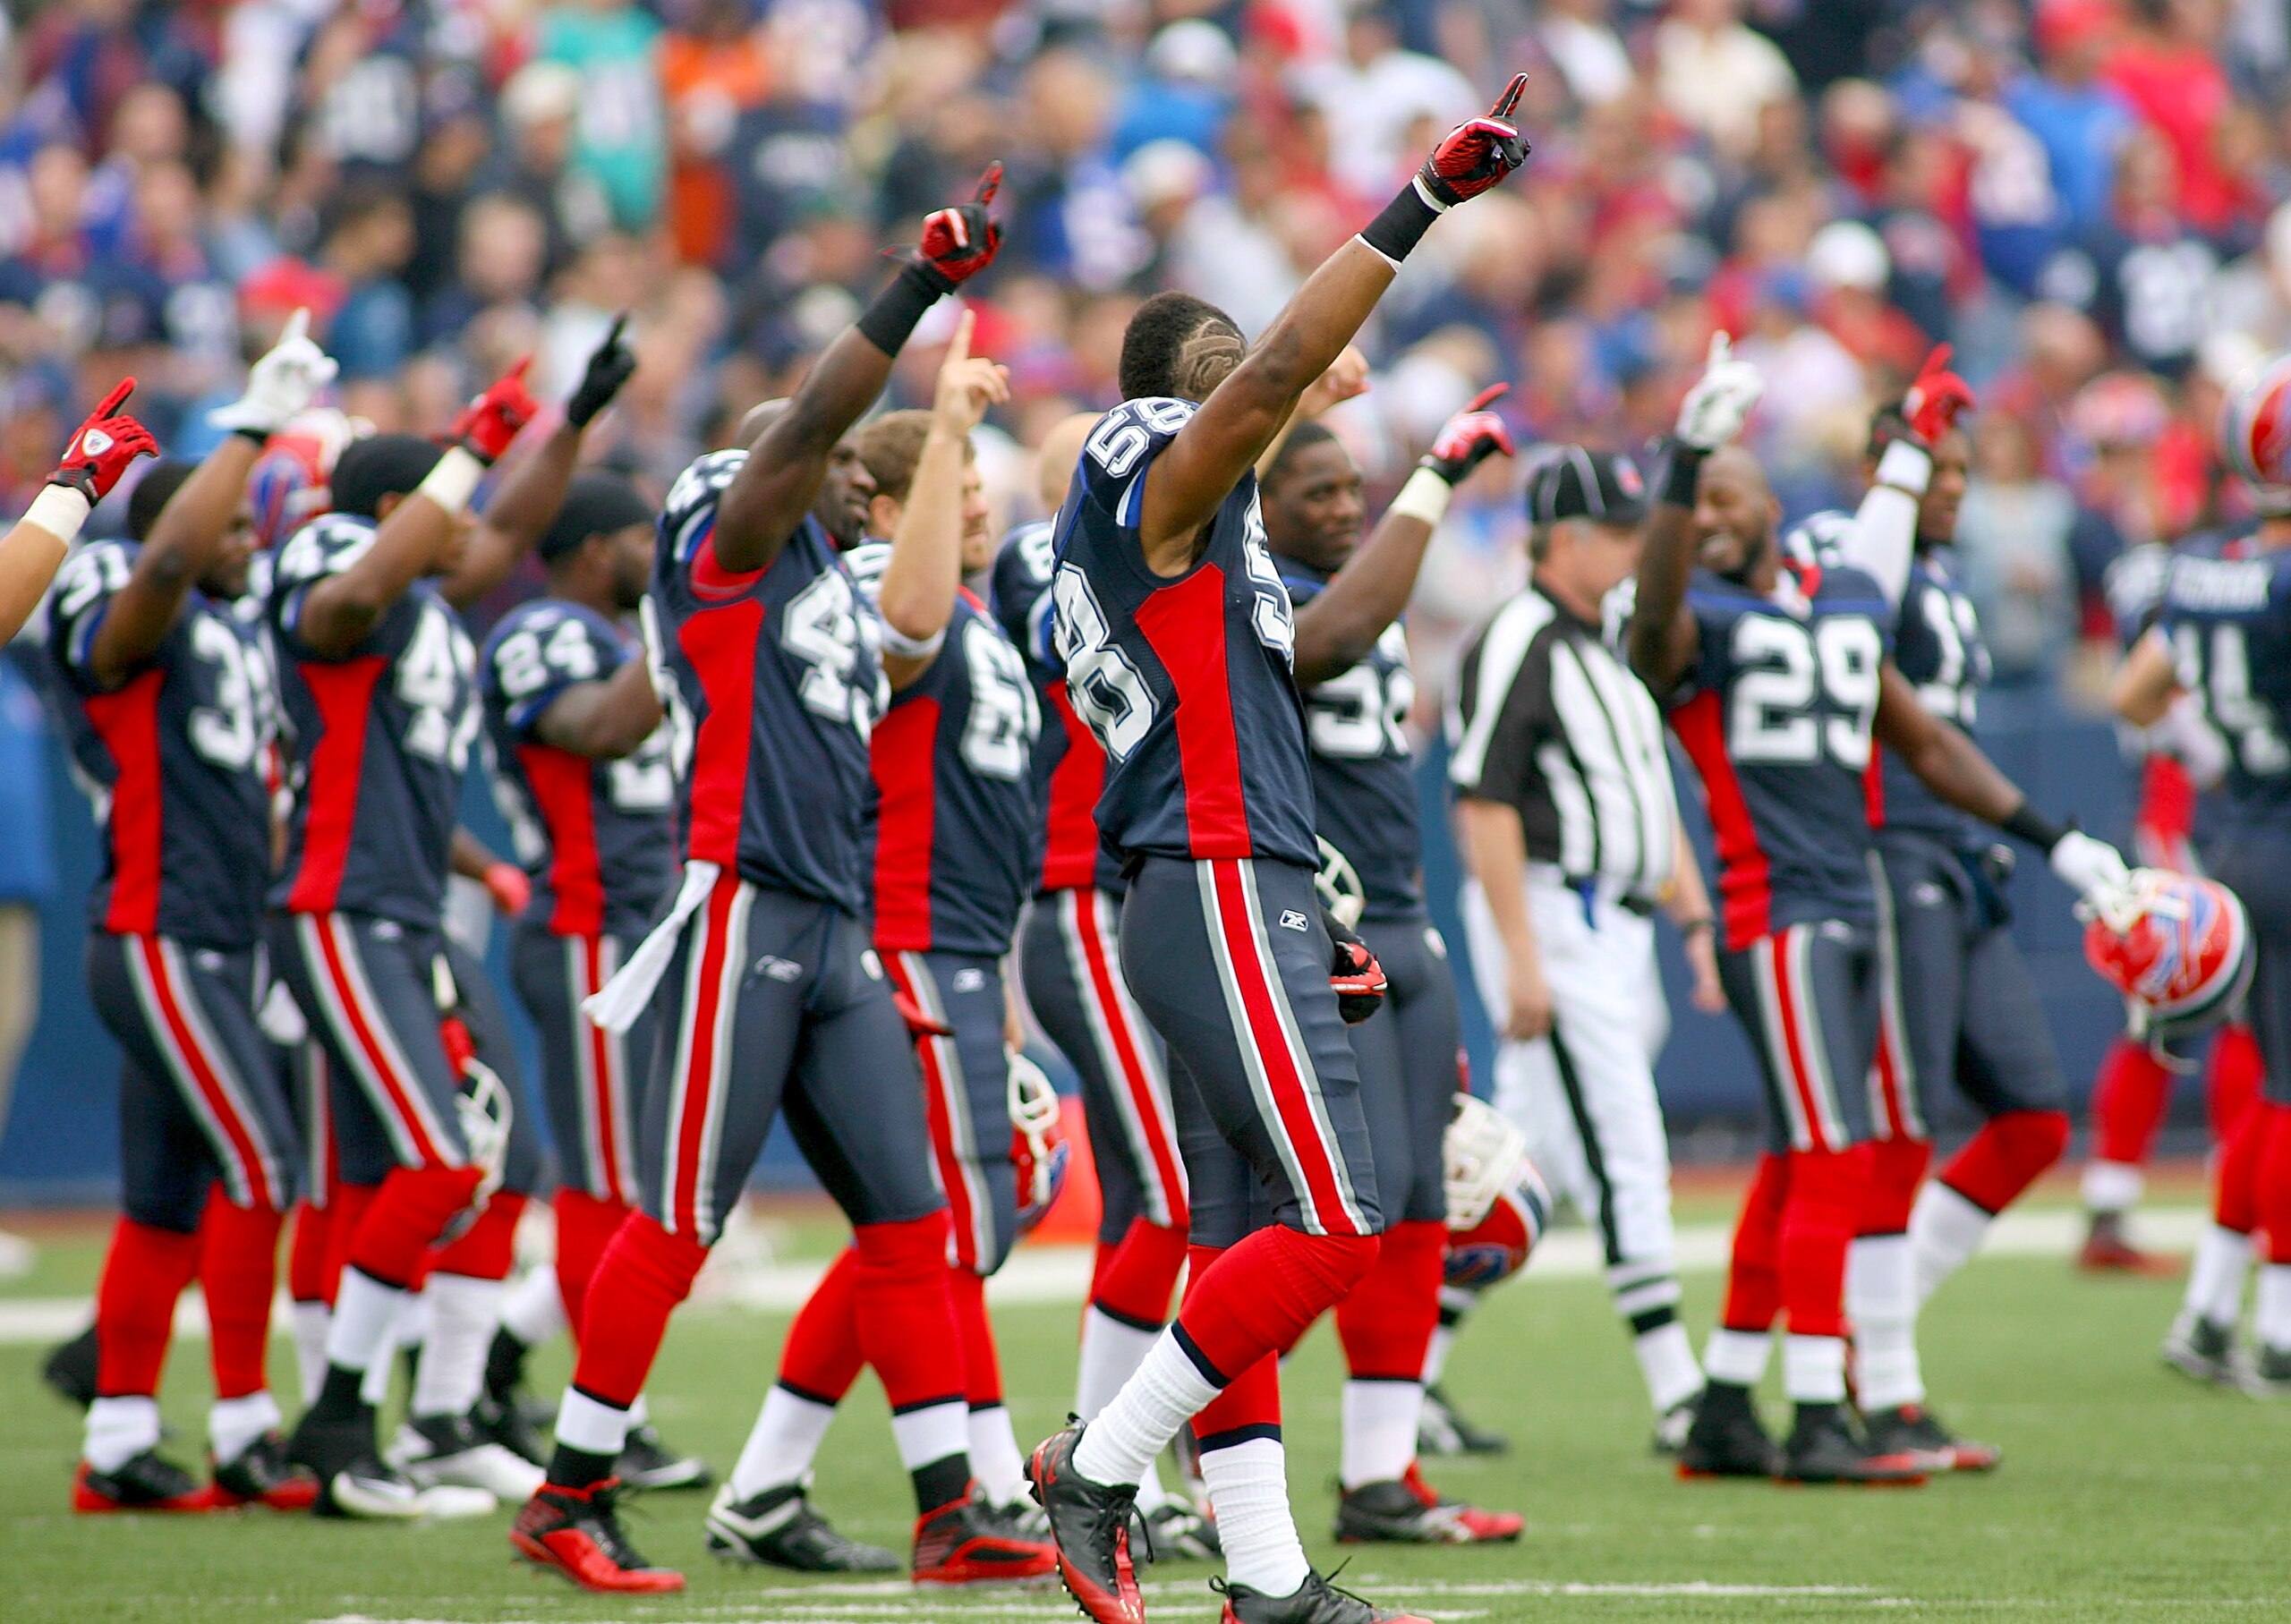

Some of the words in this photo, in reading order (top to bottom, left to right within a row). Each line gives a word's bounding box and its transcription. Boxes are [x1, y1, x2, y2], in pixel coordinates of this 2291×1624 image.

[1086, 396, 1195, 478] 58
[55, 541, 132, 616] 31
[1242, 481, 1297, 676] 5
[494, 618, 598, 700] 24
[961, 617, 1043, 782] 6
[1052, 560, 1161, 764] 8
[1729, 610, 1883, 767] 29
